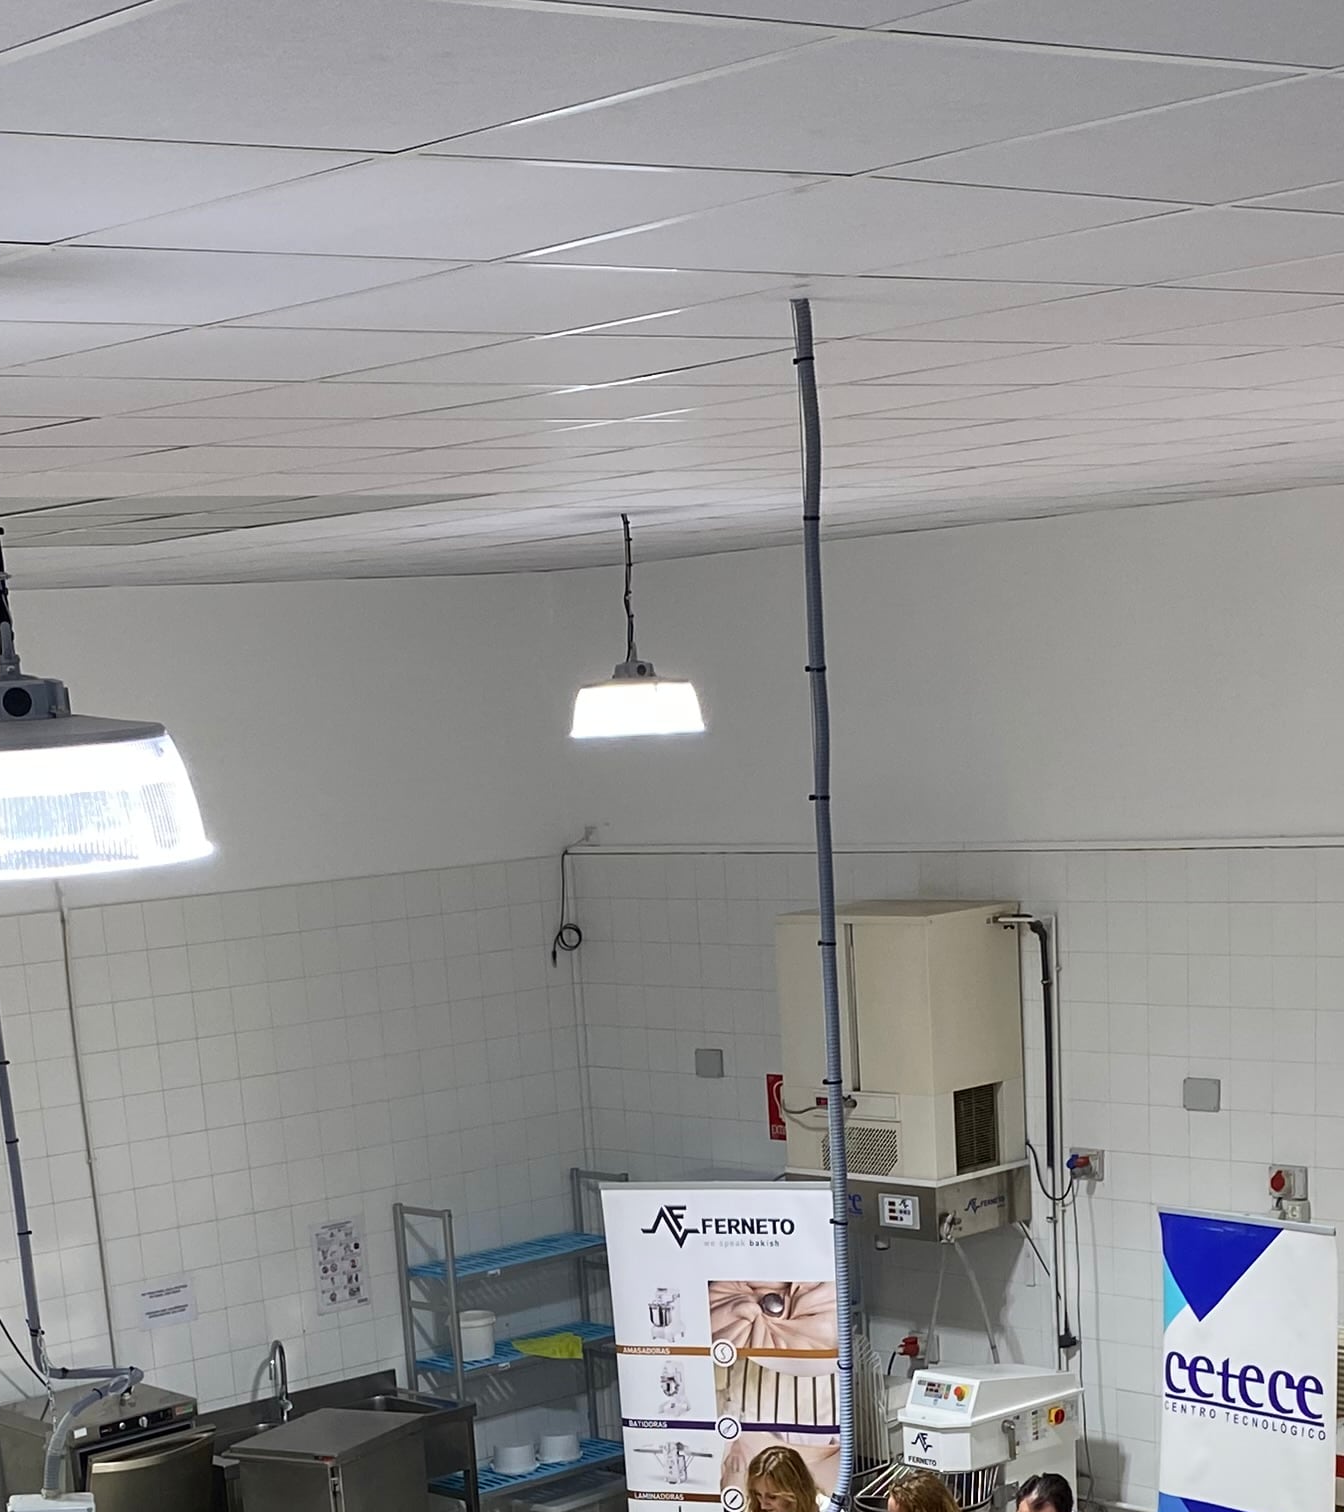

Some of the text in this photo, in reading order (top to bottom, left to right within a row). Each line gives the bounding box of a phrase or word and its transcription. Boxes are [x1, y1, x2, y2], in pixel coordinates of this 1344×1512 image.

[701, 1218, 795, 1235] FERNETO
[719, 1239, 746, 1248] speak
[749, 1239, 780, 1247] bakish
[1165, 1351, 1324, 1420] cetece
[1164, 1401, 1326, 1441] CENTRO TECNOLÓGICO
[908, 1455, 937, 1467] FERNETO
